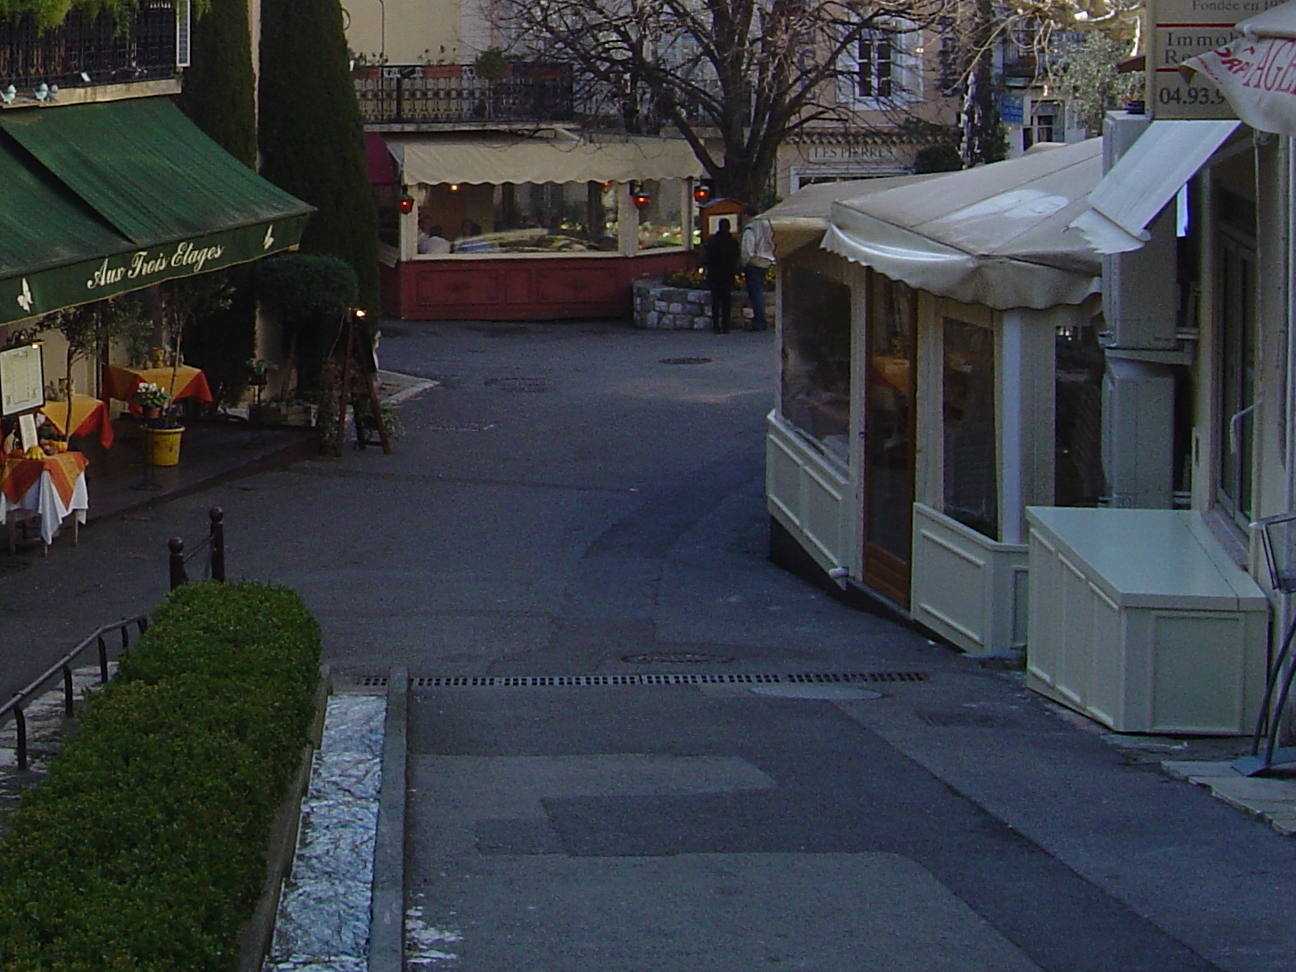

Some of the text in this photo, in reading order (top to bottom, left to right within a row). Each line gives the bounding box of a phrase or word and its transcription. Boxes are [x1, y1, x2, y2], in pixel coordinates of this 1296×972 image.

[1192, 0, 1239, 11] Fondée
[1243, 3, 1259, 11] en
[1167, 31, 1240, 46] Immob
[1242, 38, 1296, 94] AGE
[87, 241, 225, 289] Aux Trois Etages
